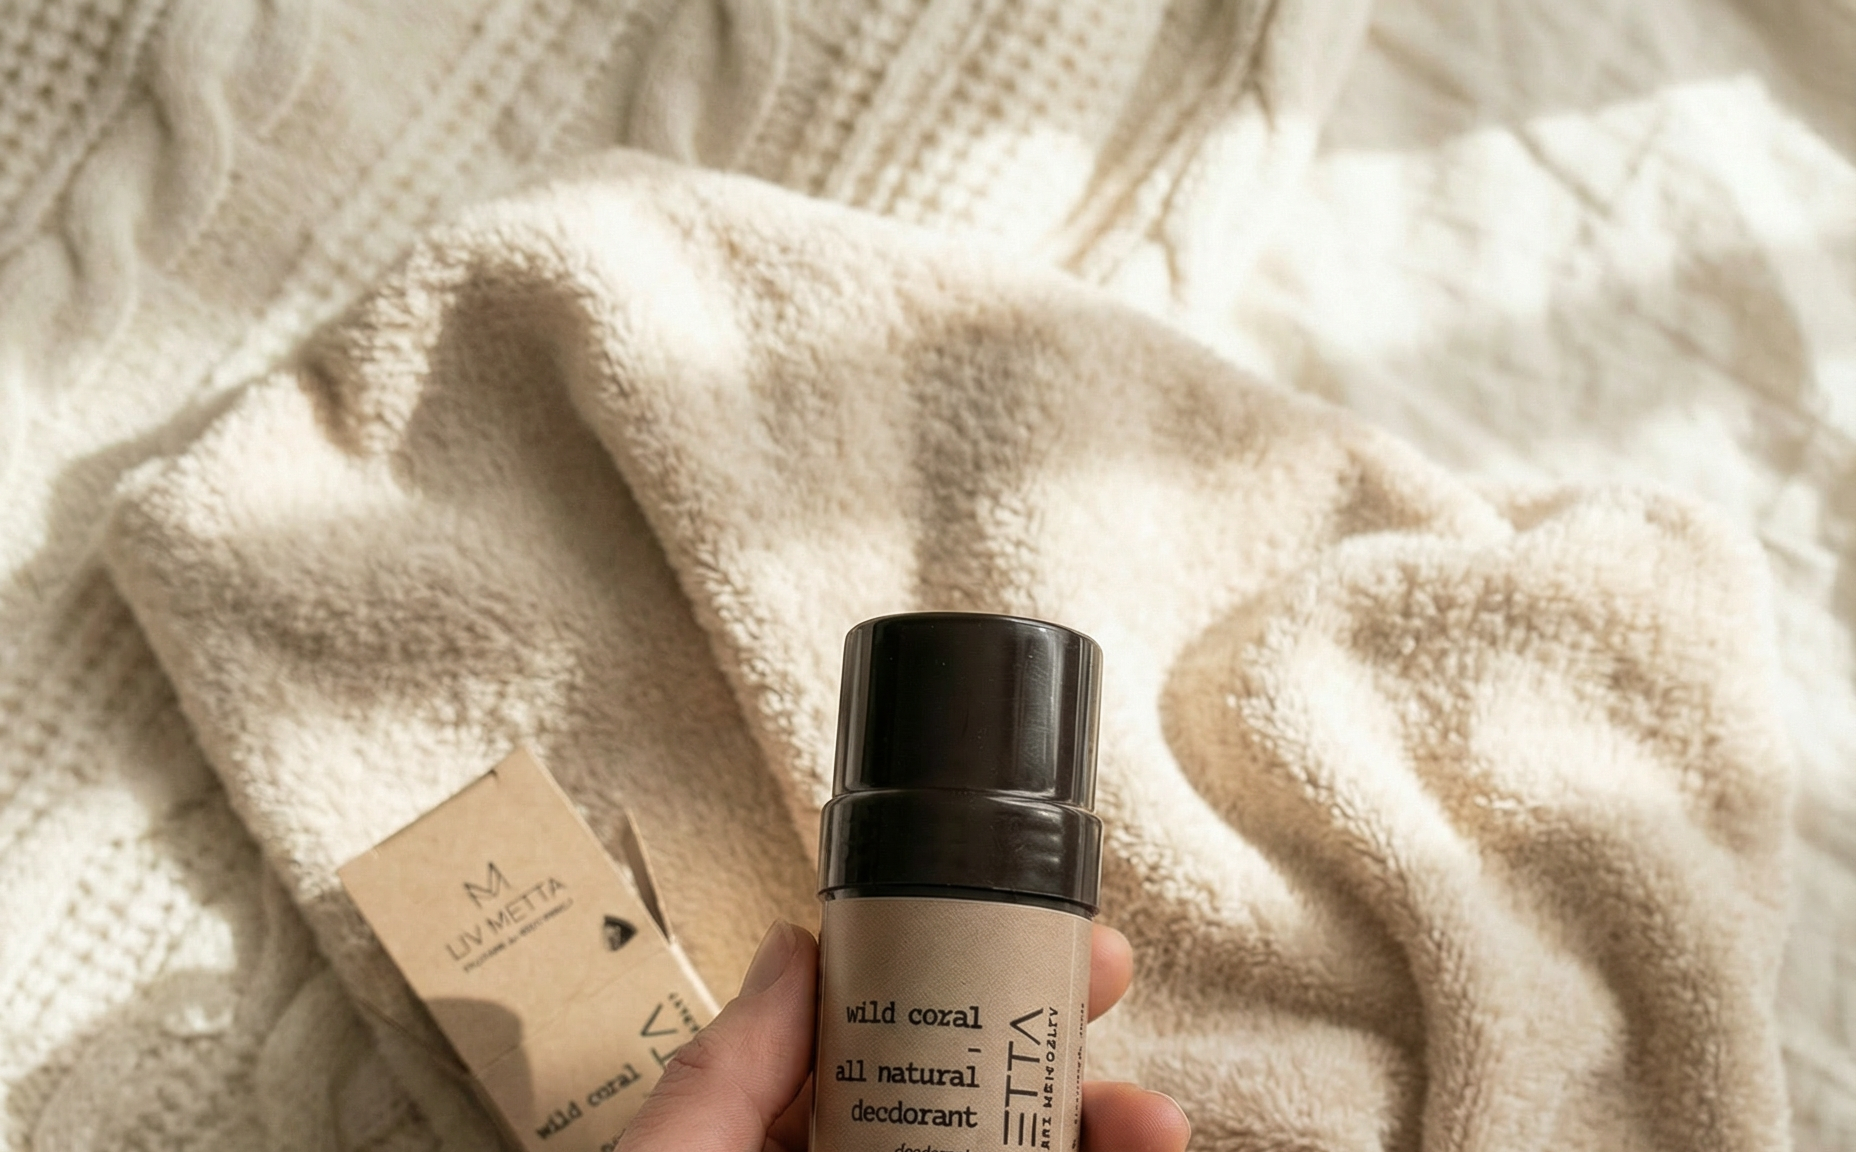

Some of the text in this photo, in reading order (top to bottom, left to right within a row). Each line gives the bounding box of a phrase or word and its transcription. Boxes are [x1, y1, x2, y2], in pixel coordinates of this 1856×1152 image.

[486, 877, 566, 935] METTA
[846, 1000, 982, 1030] wild coral
[836, 1060, 980, 1088] all natural
[536, 1063, 641, 1140] wild coral
